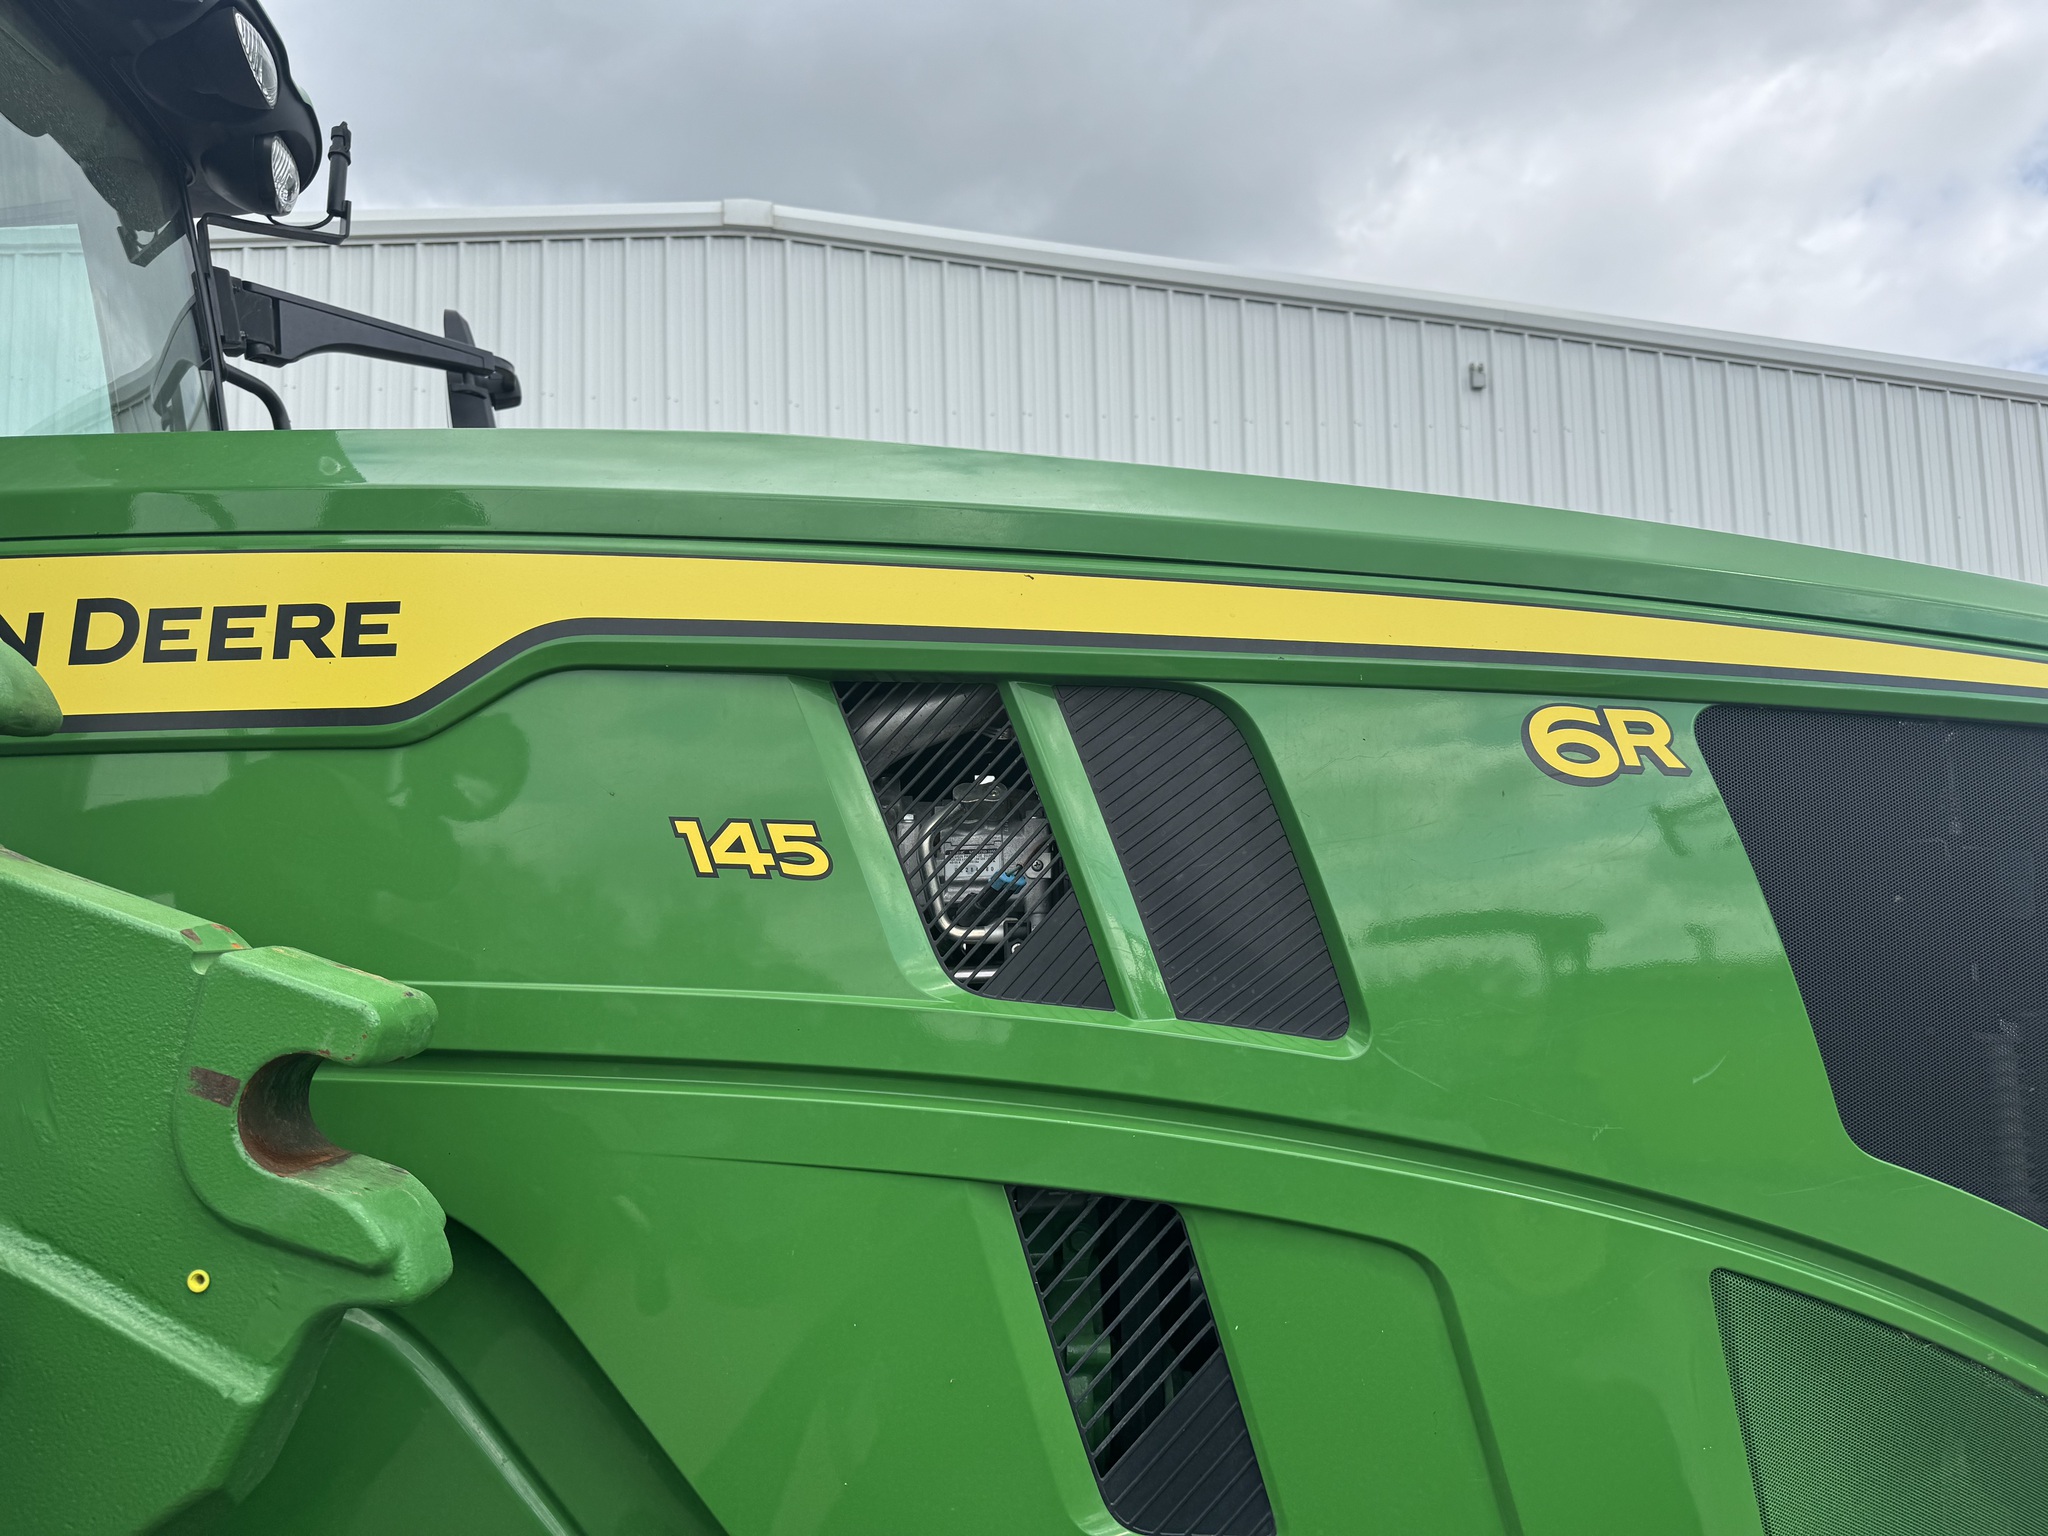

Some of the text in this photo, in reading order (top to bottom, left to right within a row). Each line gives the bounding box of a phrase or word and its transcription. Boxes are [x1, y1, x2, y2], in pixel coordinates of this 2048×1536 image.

[68, 597, 401, 666] DEERE
[1521, 703, 1693, 787] 6R
[669, 816, 834, 881] 145
